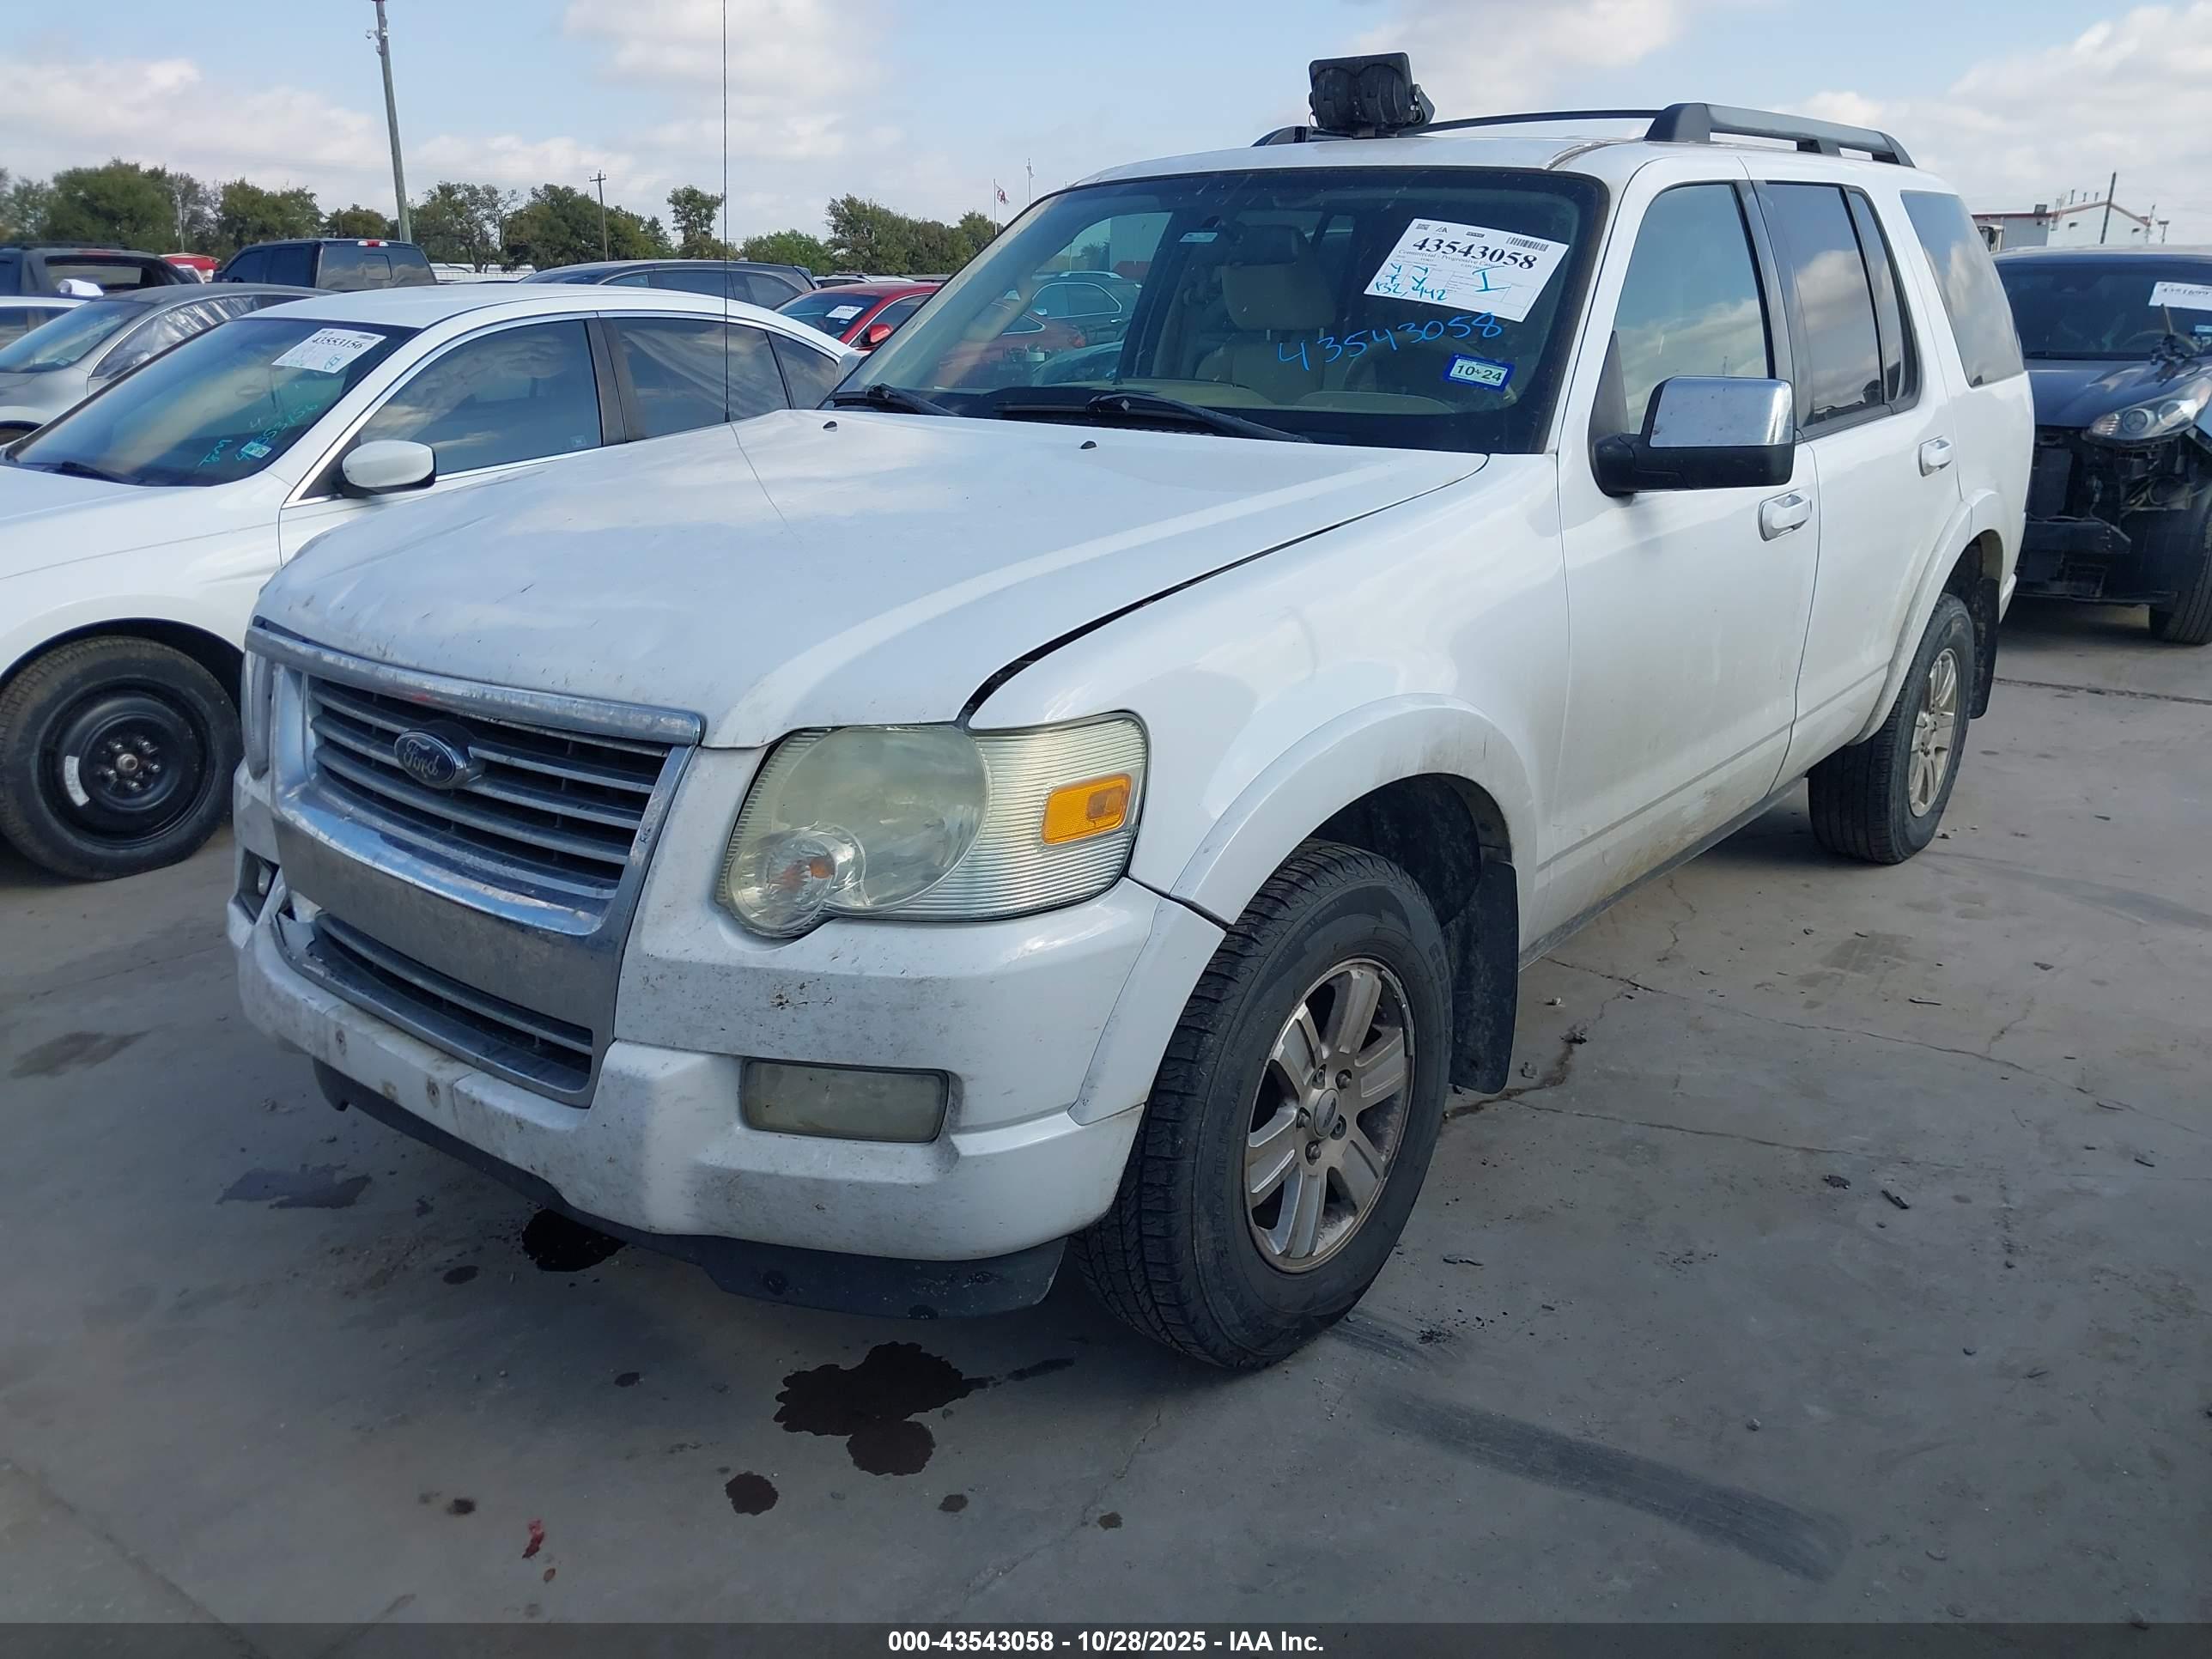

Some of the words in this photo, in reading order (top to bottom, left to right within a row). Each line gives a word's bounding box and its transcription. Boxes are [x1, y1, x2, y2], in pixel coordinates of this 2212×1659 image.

[1413, 237, 1537, 269] 43543058
[1278, 313, 1502, 371] 43543058
[404, 739, 440, 778] Ford
